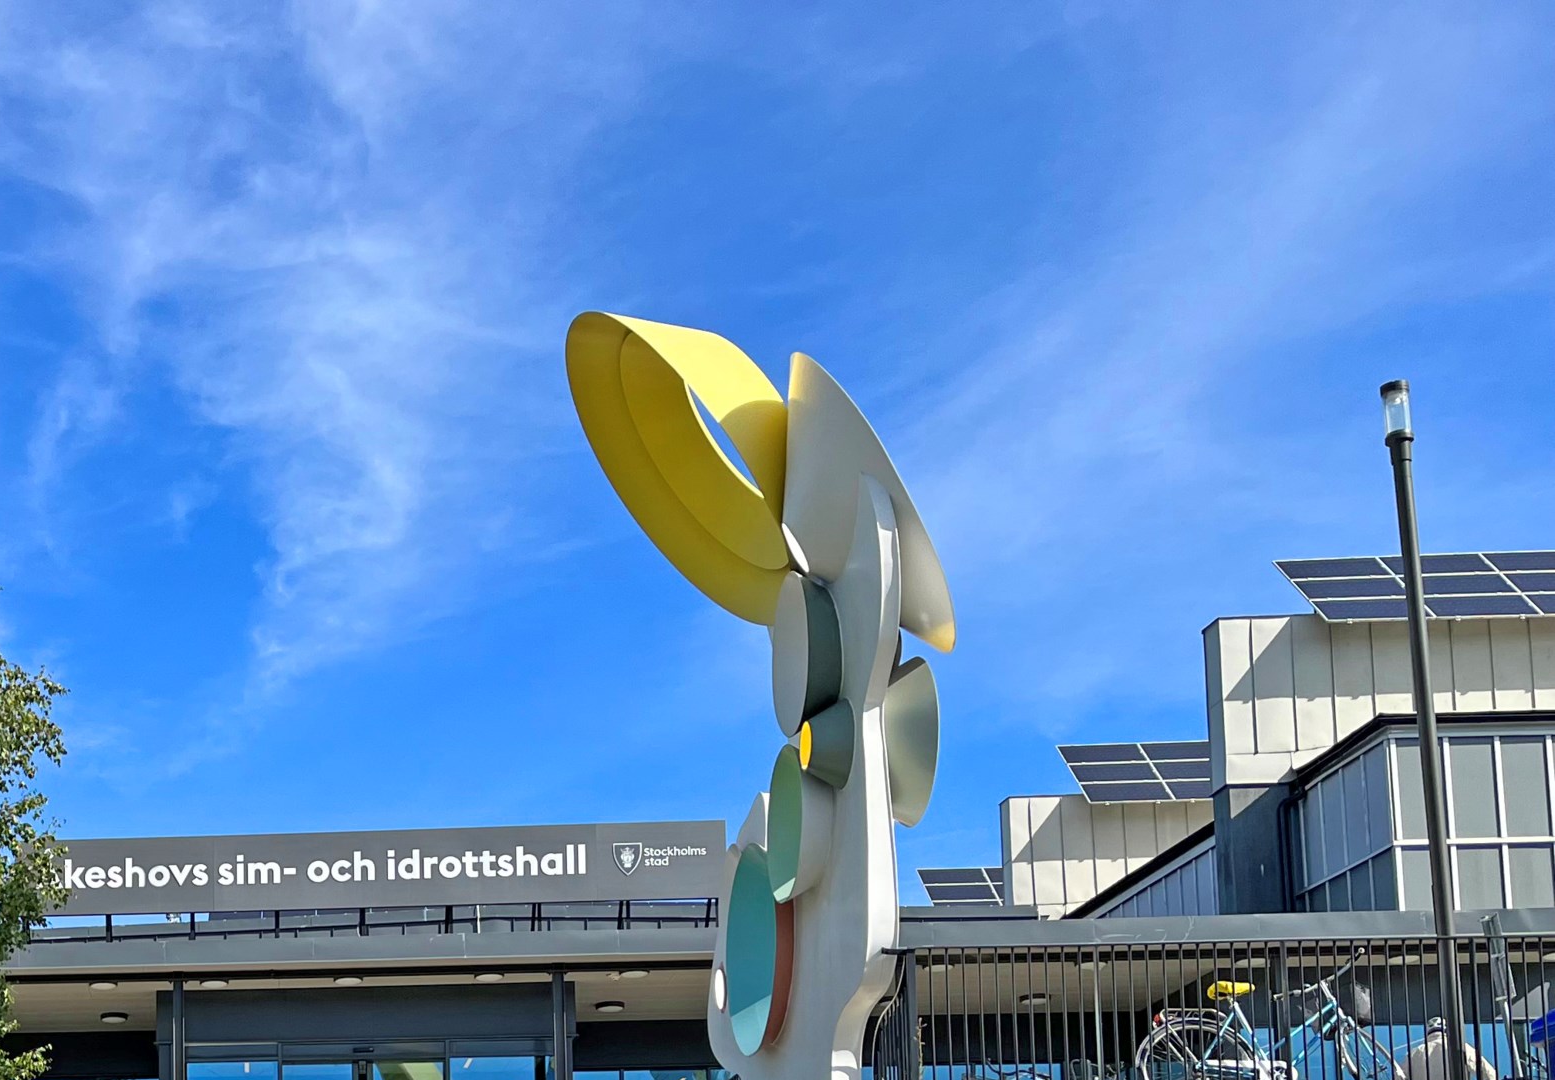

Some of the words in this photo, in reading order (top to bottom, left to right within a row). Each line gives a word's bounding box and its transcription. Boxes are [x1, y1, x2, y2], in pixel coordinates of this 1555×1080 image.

[643, 846, 707, 857] Stockholms
[217, 854, 297, 886] sim-
[306, 850, 376, 883] och
[386, 843, 587, 881] idrottshall
[644, 856, 670, 867] stad
